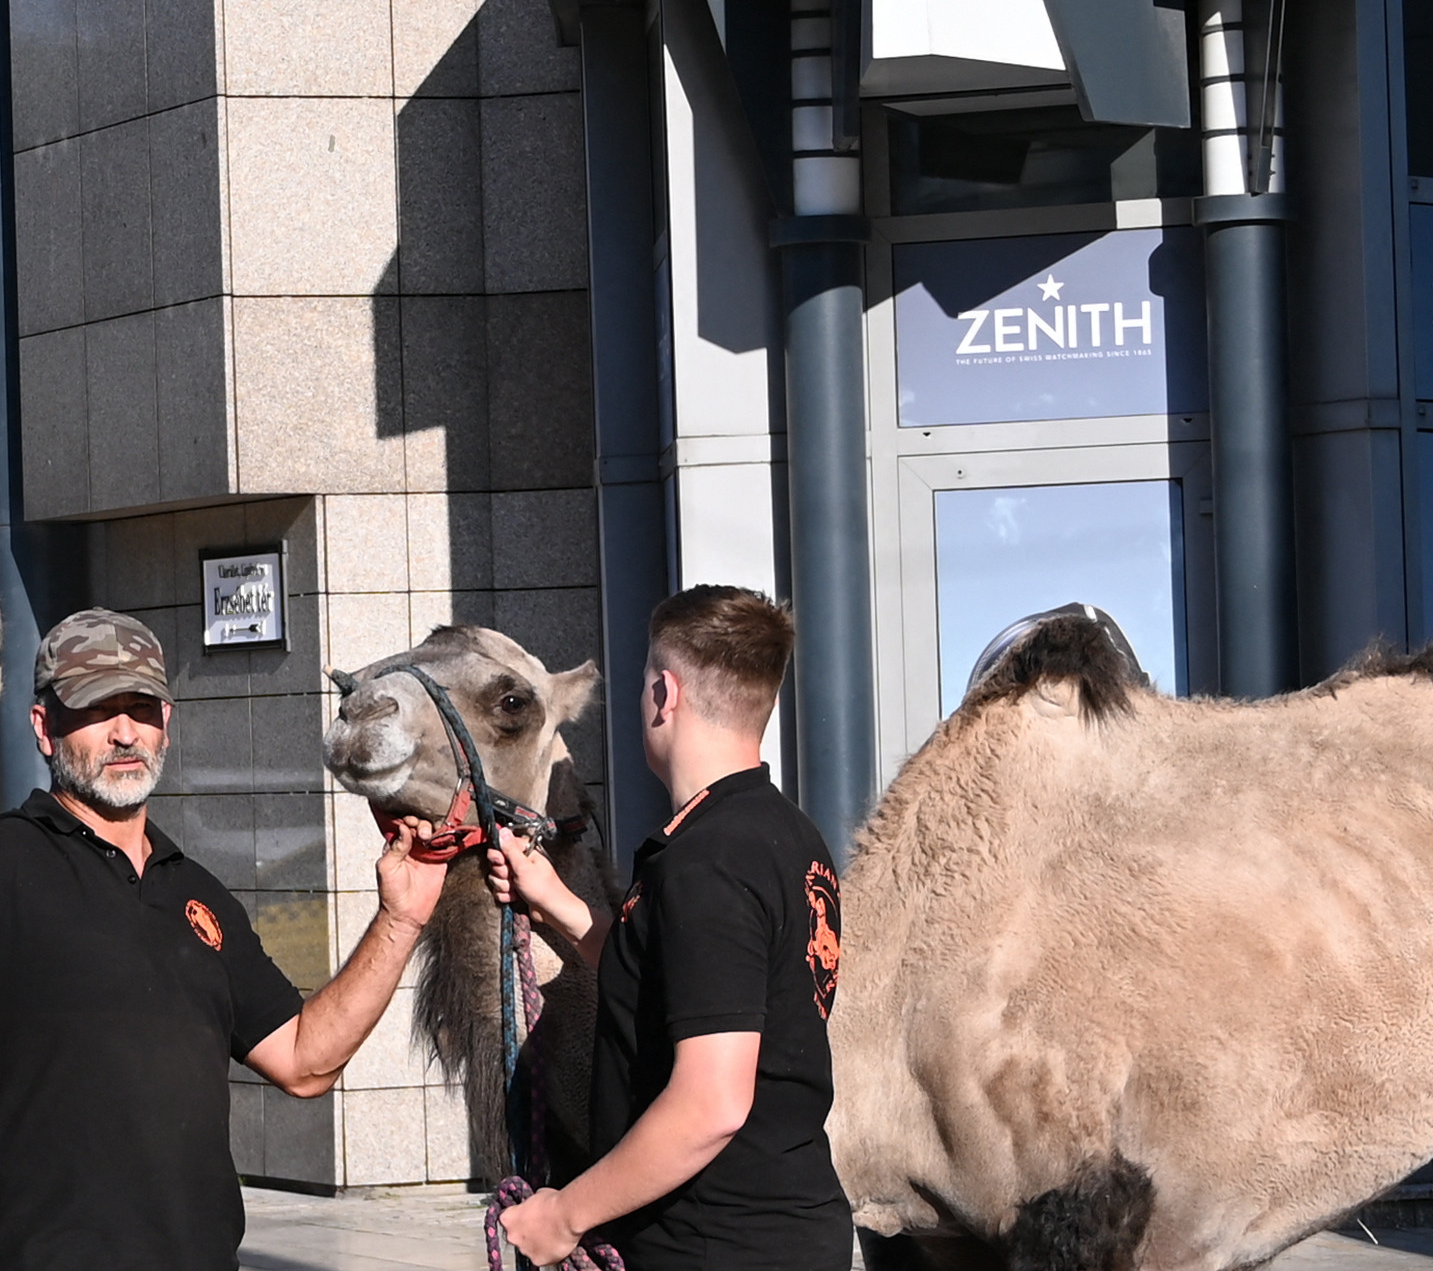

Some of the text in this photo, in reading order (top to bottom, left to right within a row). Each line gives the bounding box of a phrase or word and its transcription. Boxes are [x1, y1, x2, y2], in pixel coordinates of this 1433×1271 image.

[955, 300, 1152, 355] ZENITH
[973, 357, 1003, 365] FUTURE
[1005, 356, 1017, 364] OF
[1019, 354, 1043, 363] SWISS
[1045, 351, 1104, 361] WATCHMAKING
[1106, 350, 1130, 358] SINCE
